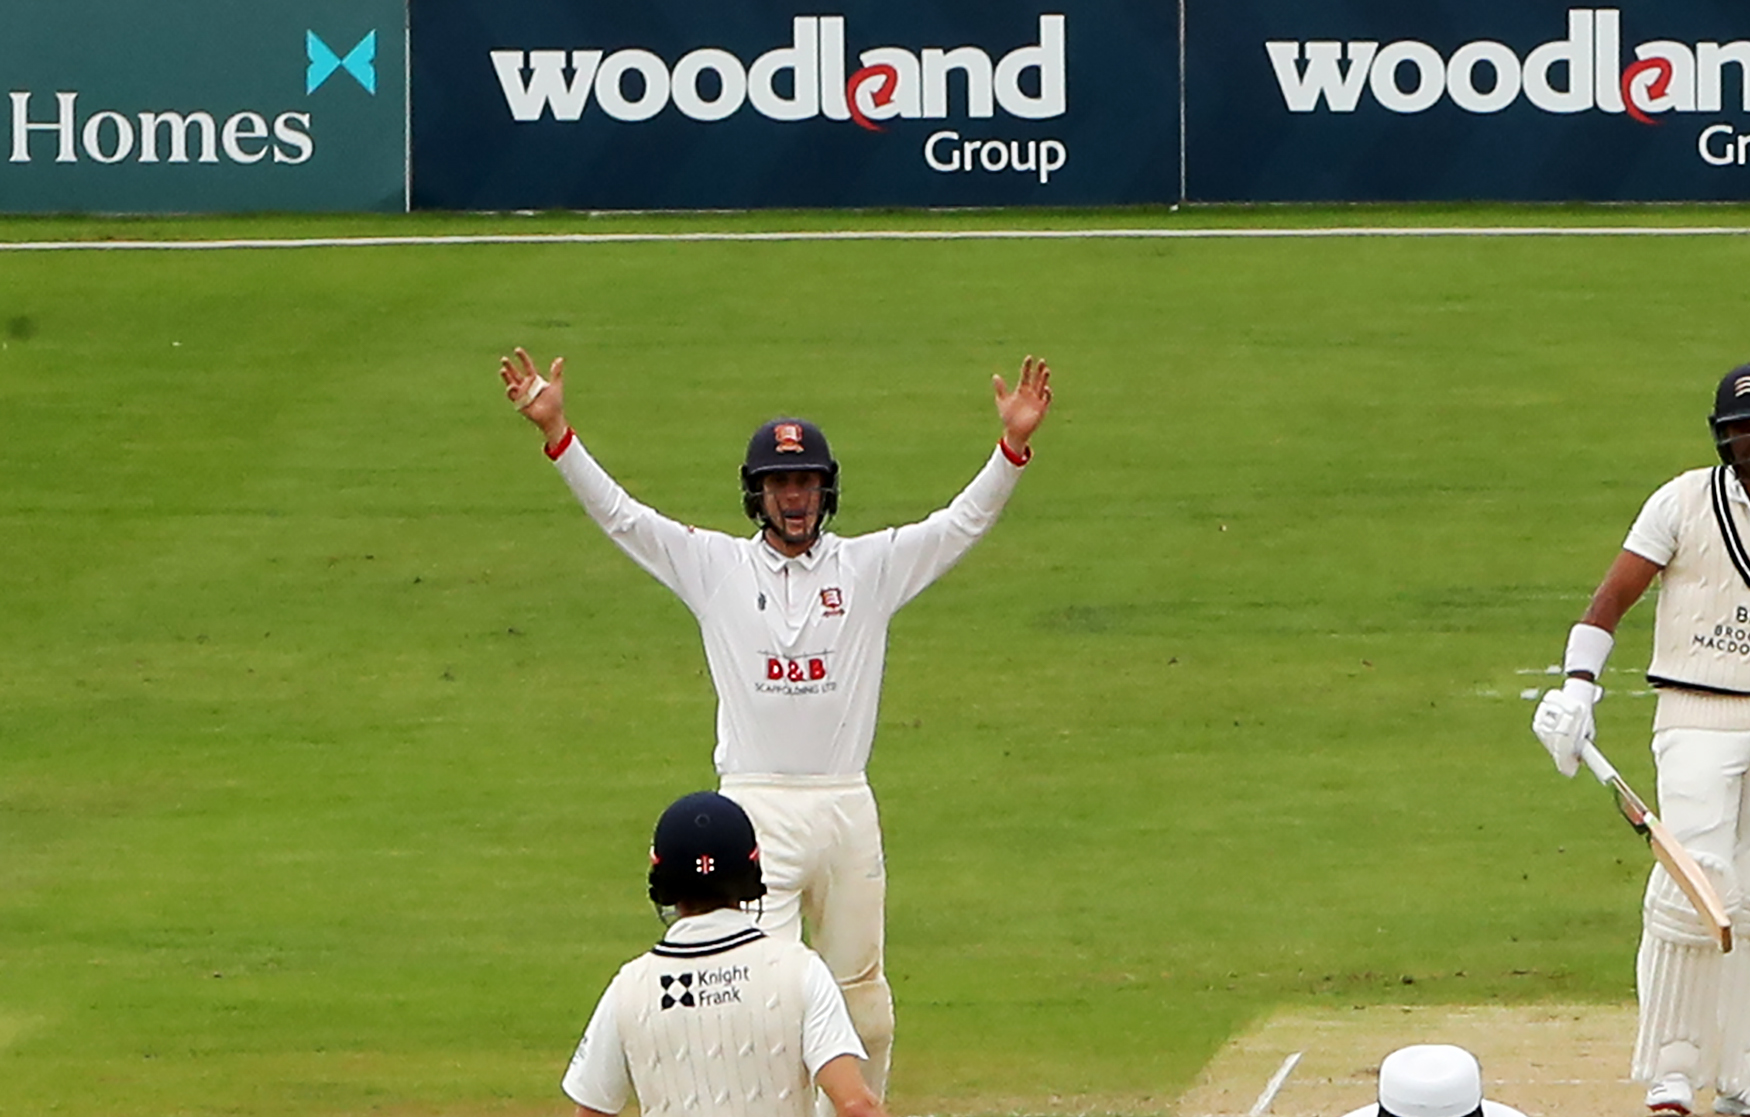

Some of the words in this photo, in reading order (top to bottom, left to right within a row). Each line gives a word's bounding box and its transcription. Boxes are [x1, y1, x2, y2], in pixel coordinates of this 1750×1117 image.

[490, 14, 1066, 131] woodland
[9, 90, 313, 164] Homes
[925, 131, 1066, 183] Group
[767, 658, 827, 682] D&B
[698, 965, 750, 987] Knight
[698, 986, 742, 1007] Frank
